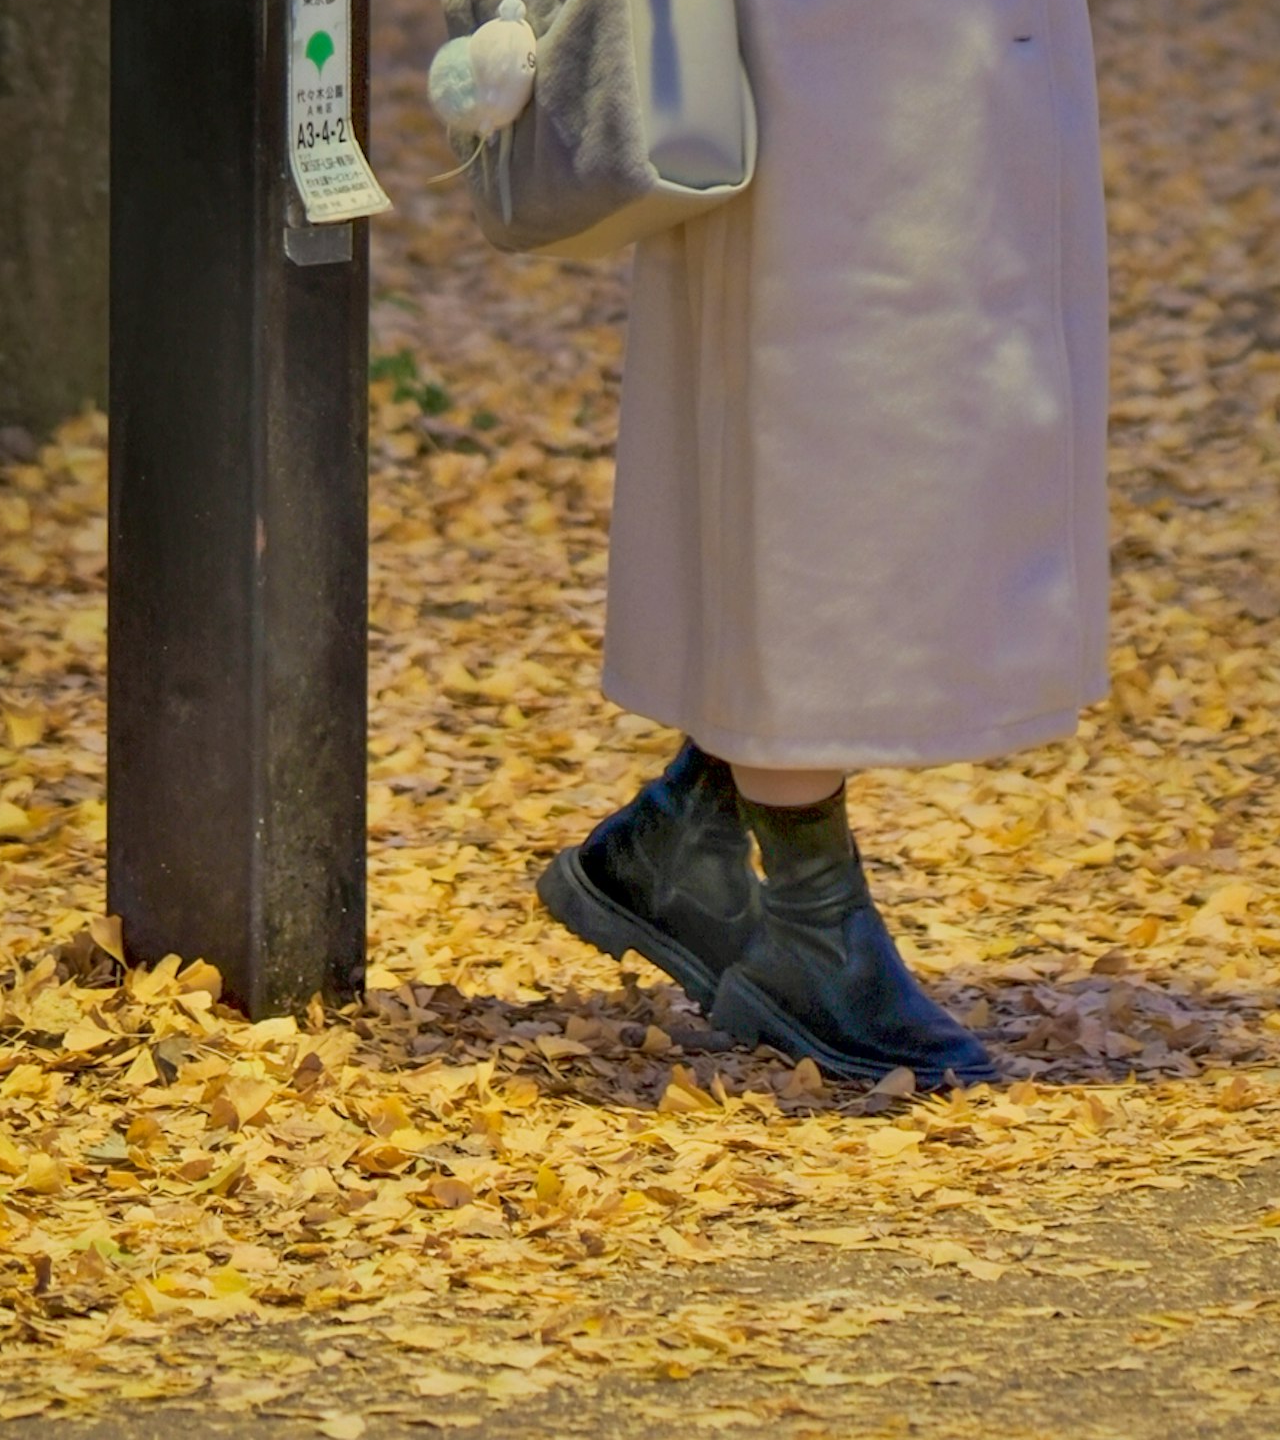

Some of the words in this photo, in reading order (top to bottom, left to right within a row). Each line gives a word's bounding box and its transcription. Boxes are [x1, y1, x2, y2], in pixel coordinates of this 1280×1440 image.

[297, 84, 344, 103] 代々木公園
[297, 117, 347, 150] A3-4-2
